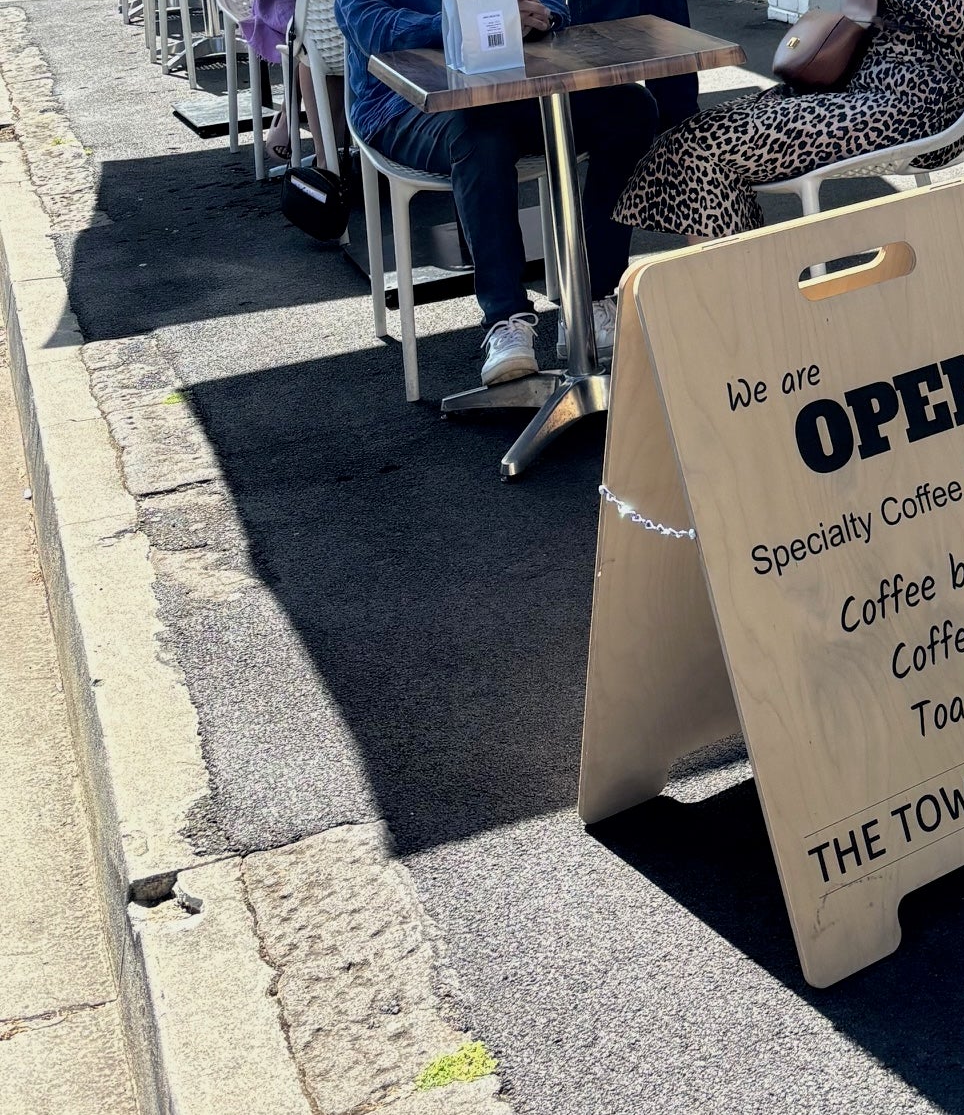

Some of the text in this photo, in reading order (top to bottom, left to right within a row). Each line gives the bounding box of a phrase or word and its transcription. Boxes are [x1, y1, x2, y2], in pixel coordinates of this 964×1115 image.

[726, 363, 821, 412] We are
[750, 511, 873, 576] Specialty
[880, 482, 963, 526] Coffee
[840, 573, 936, 632] Coffee
[807, 818, 888, 883] THE
